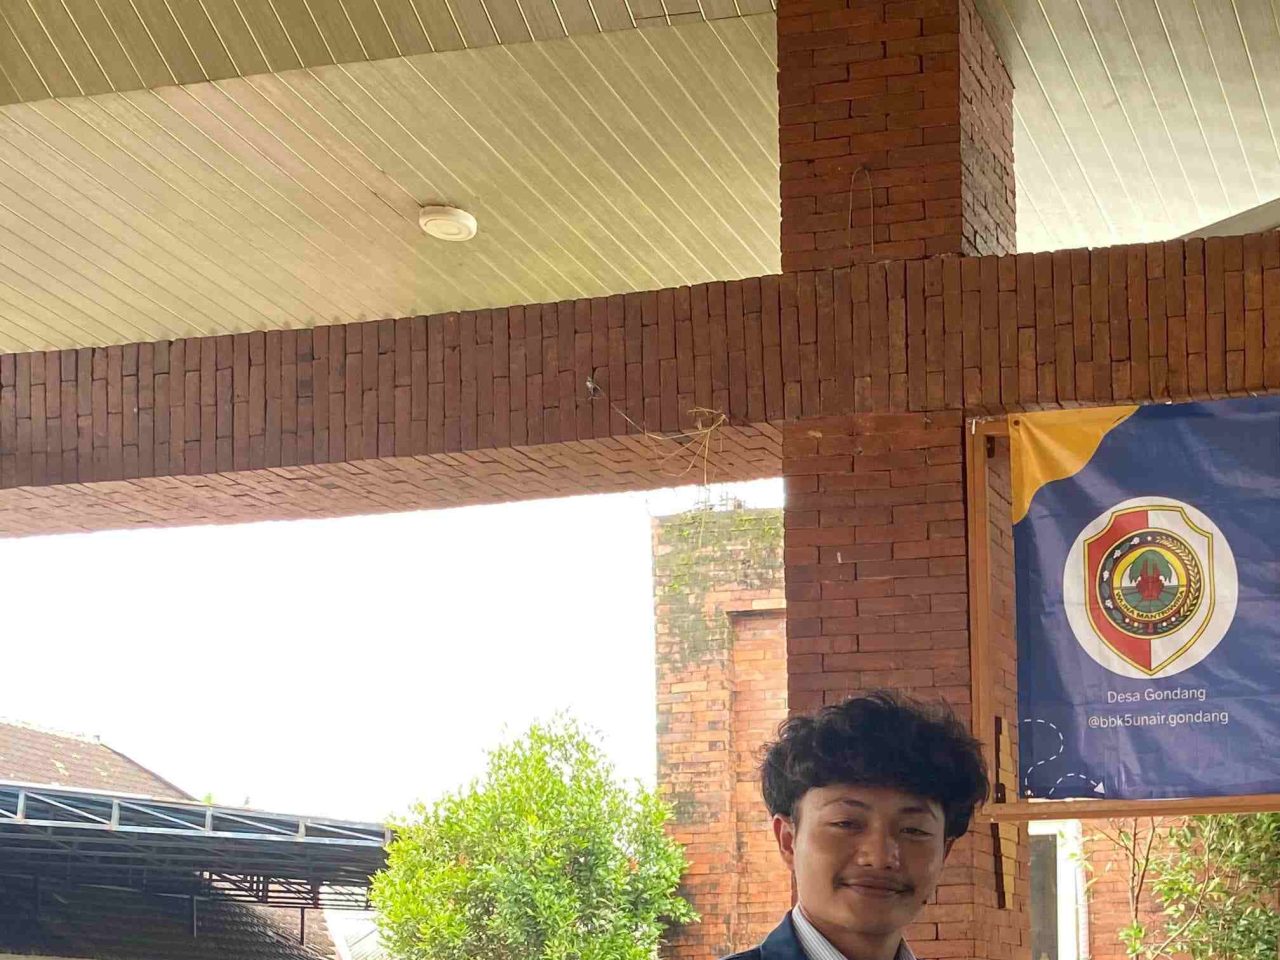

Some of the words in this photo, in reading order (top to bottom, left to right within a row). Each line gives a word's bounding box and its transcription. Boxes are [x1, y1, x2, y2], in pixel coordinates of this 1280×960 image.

[1107, 690, 1140, 704] Desa
[1144, 687, 1206, 701] Gondang
[1088, 710, 1228, 729] @bbk5unair.gondang
